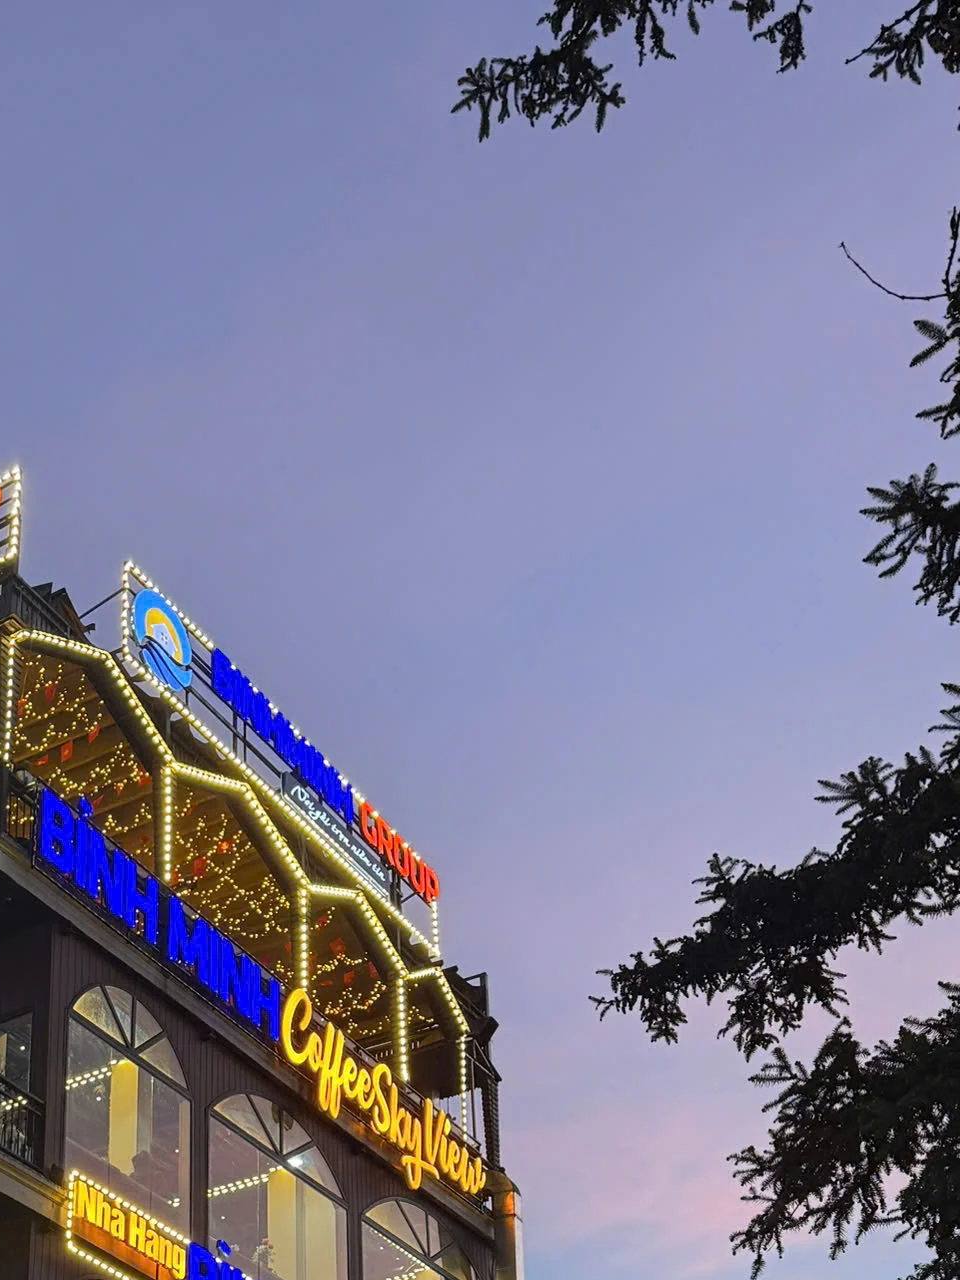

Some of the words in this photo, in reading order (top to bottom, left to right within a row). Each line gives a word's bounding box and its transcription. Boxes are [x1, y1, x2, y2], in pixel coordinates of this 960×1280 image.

[40, 787, 159, 946] BÌNH
[168, 896, 281, 1042] MINH
[359, 801, 439, 904] GROUP
